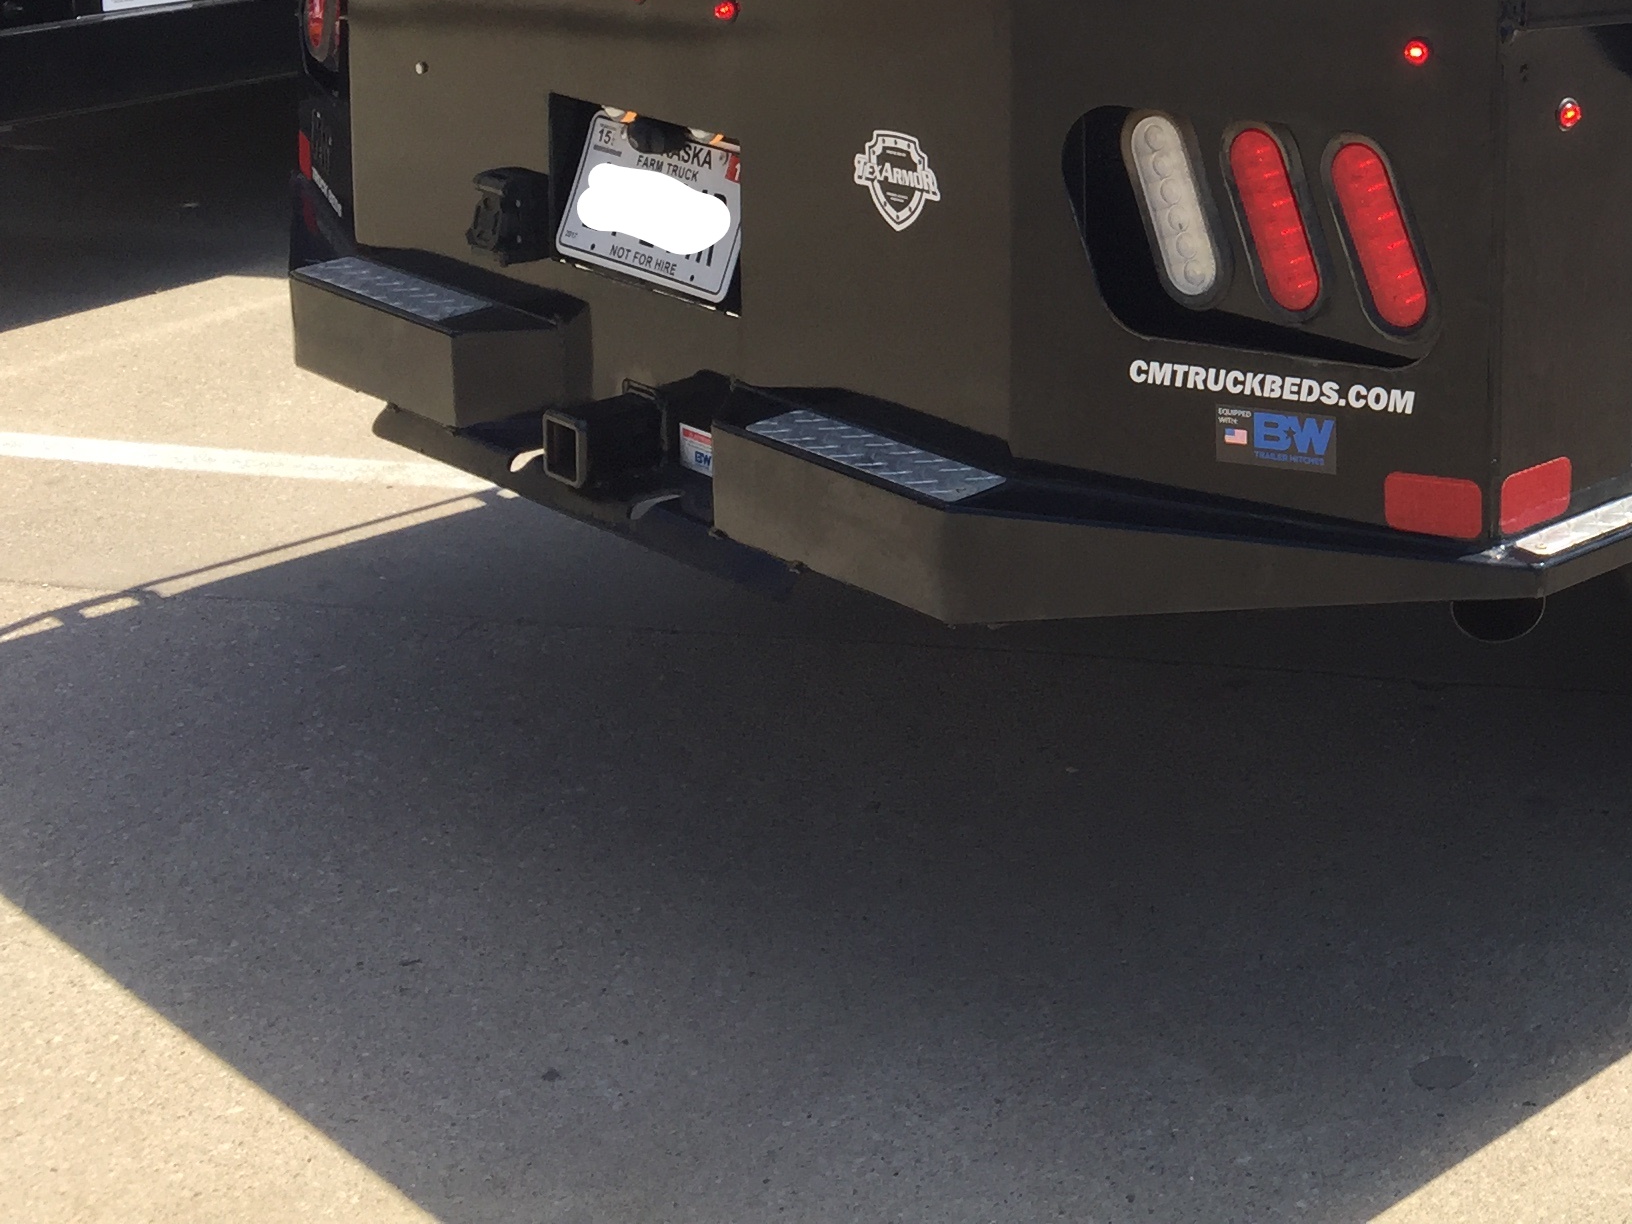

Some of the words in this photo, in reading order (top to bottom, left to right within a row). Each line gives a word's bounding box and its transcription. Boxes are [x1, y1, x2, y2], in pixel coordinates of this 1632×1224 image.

[636, 154, 663, 173] FARM
[667, 164, 699, 183] TRUCK
[610, 244, 632, 260] NOT
[632, 251, 654, 268] FOR
[655, 257, 678, 276] HIRE
[1129, 360, 1416, 414] CMTRUCKBEDS.COM
[1218, 407, 1252, 418] EQUIPPED
[1254, 450, 1289, 462] TRAILER
[1290, 455, 1325, 466] HITCHES
